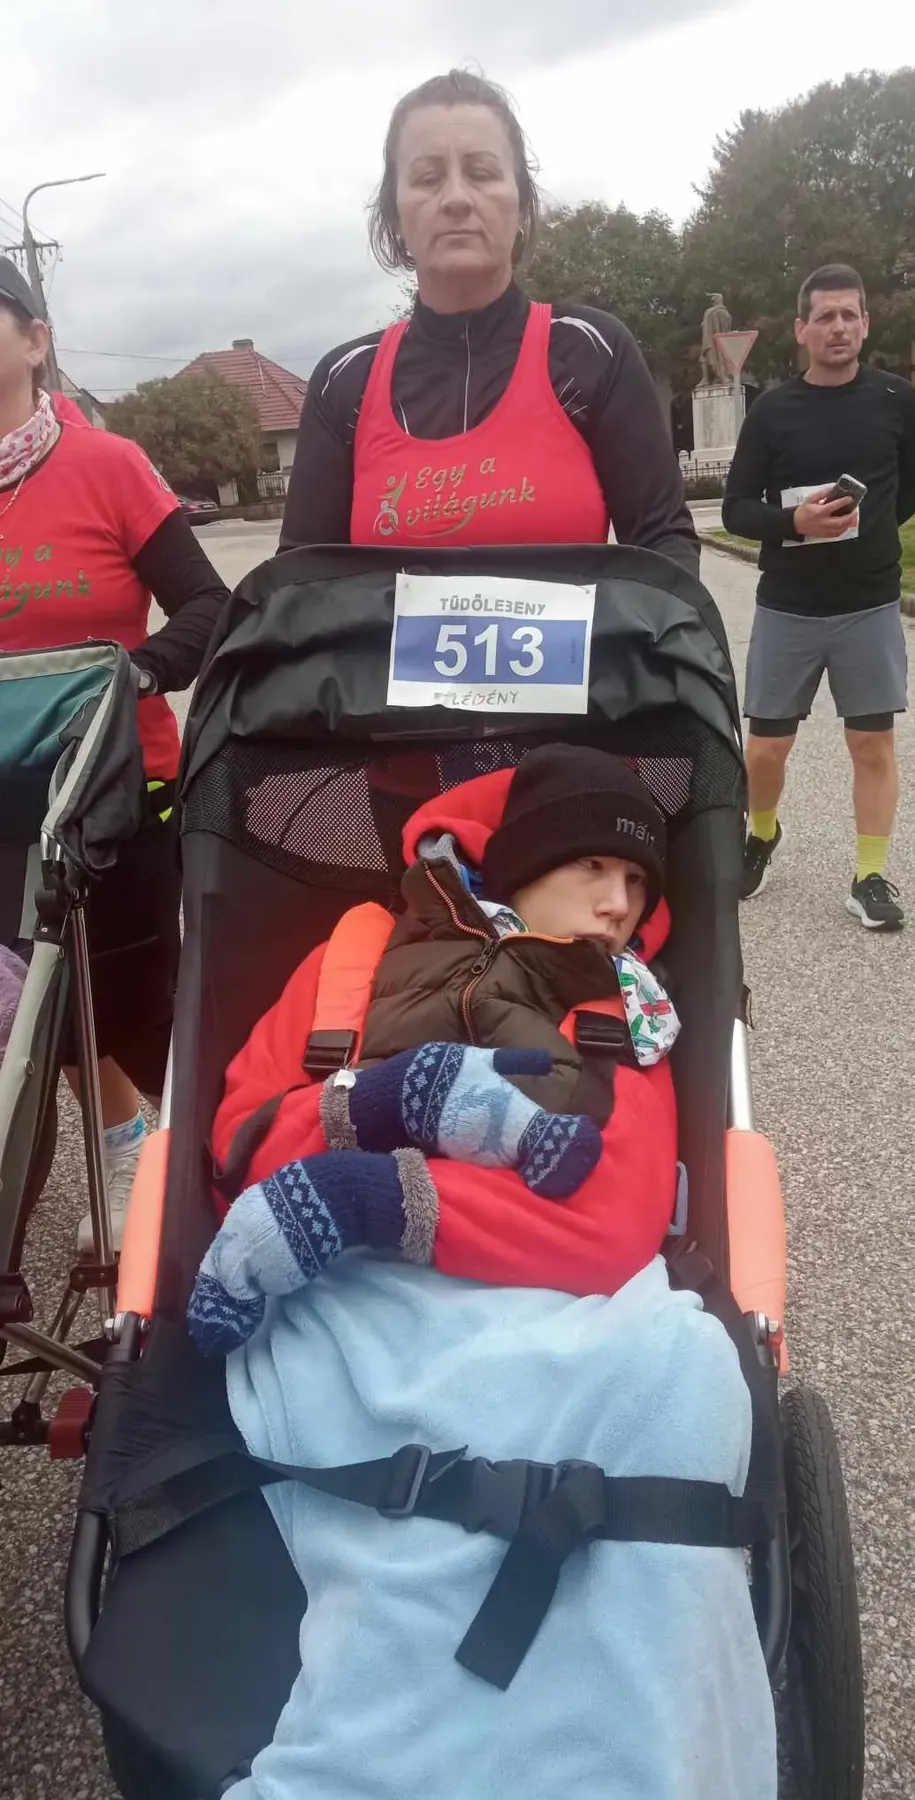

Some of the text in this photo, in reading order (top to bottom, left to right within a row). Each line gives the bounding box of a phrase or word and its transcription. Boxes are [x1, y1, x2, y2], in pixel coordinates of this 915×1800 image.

[415, 456, 496, 492] Egy a
[405, 477, 536, 526] világunk
[35, 543, 53, 562] a
[433, 623, 545, 677] 513
